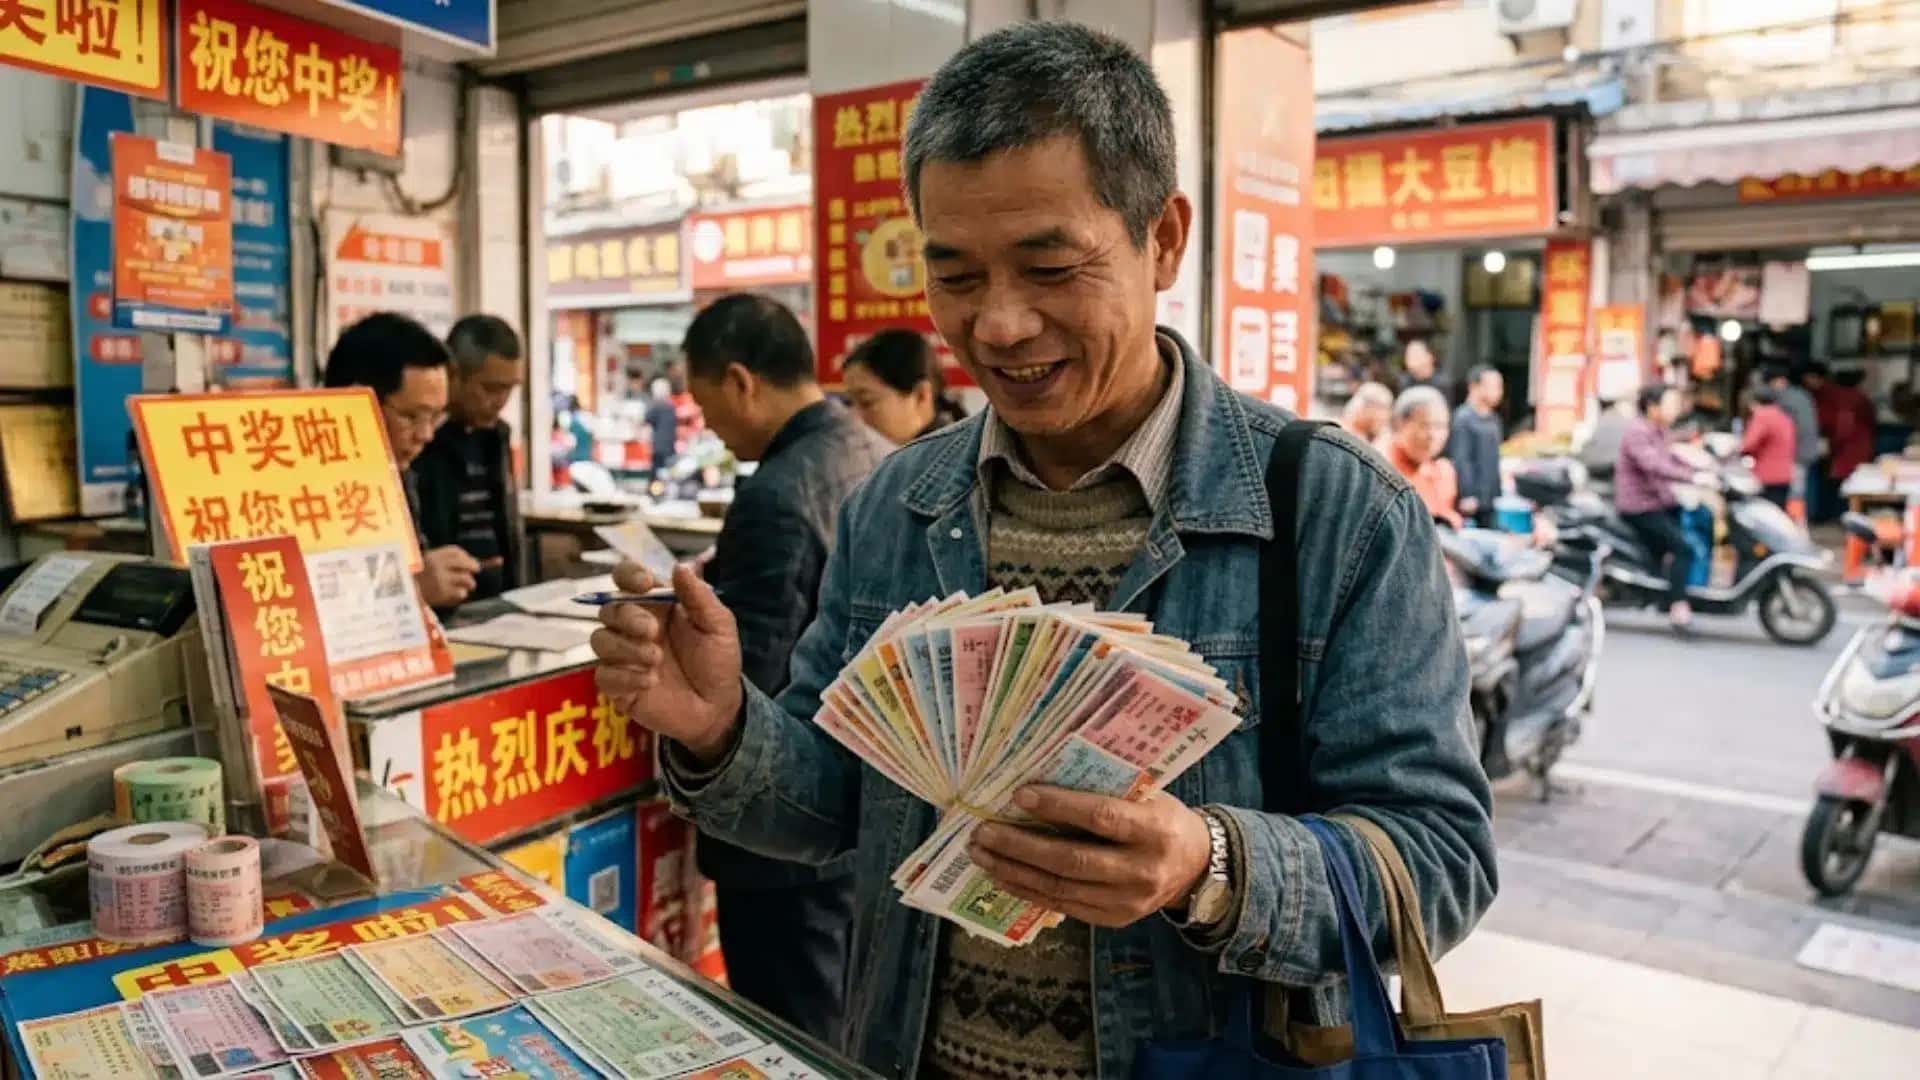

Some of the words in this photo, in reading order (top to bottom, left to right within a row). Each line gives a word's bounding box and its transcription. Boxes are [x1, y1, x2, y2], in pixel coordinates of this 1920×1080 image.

[190, 10, 395, 131] 祝您中奖!
[181, 408, 361, 475] 中奖啦!
[184, 480, 392, 543] 祝您中奖!
[434, 692, 633, 823] 热烈庆祝
